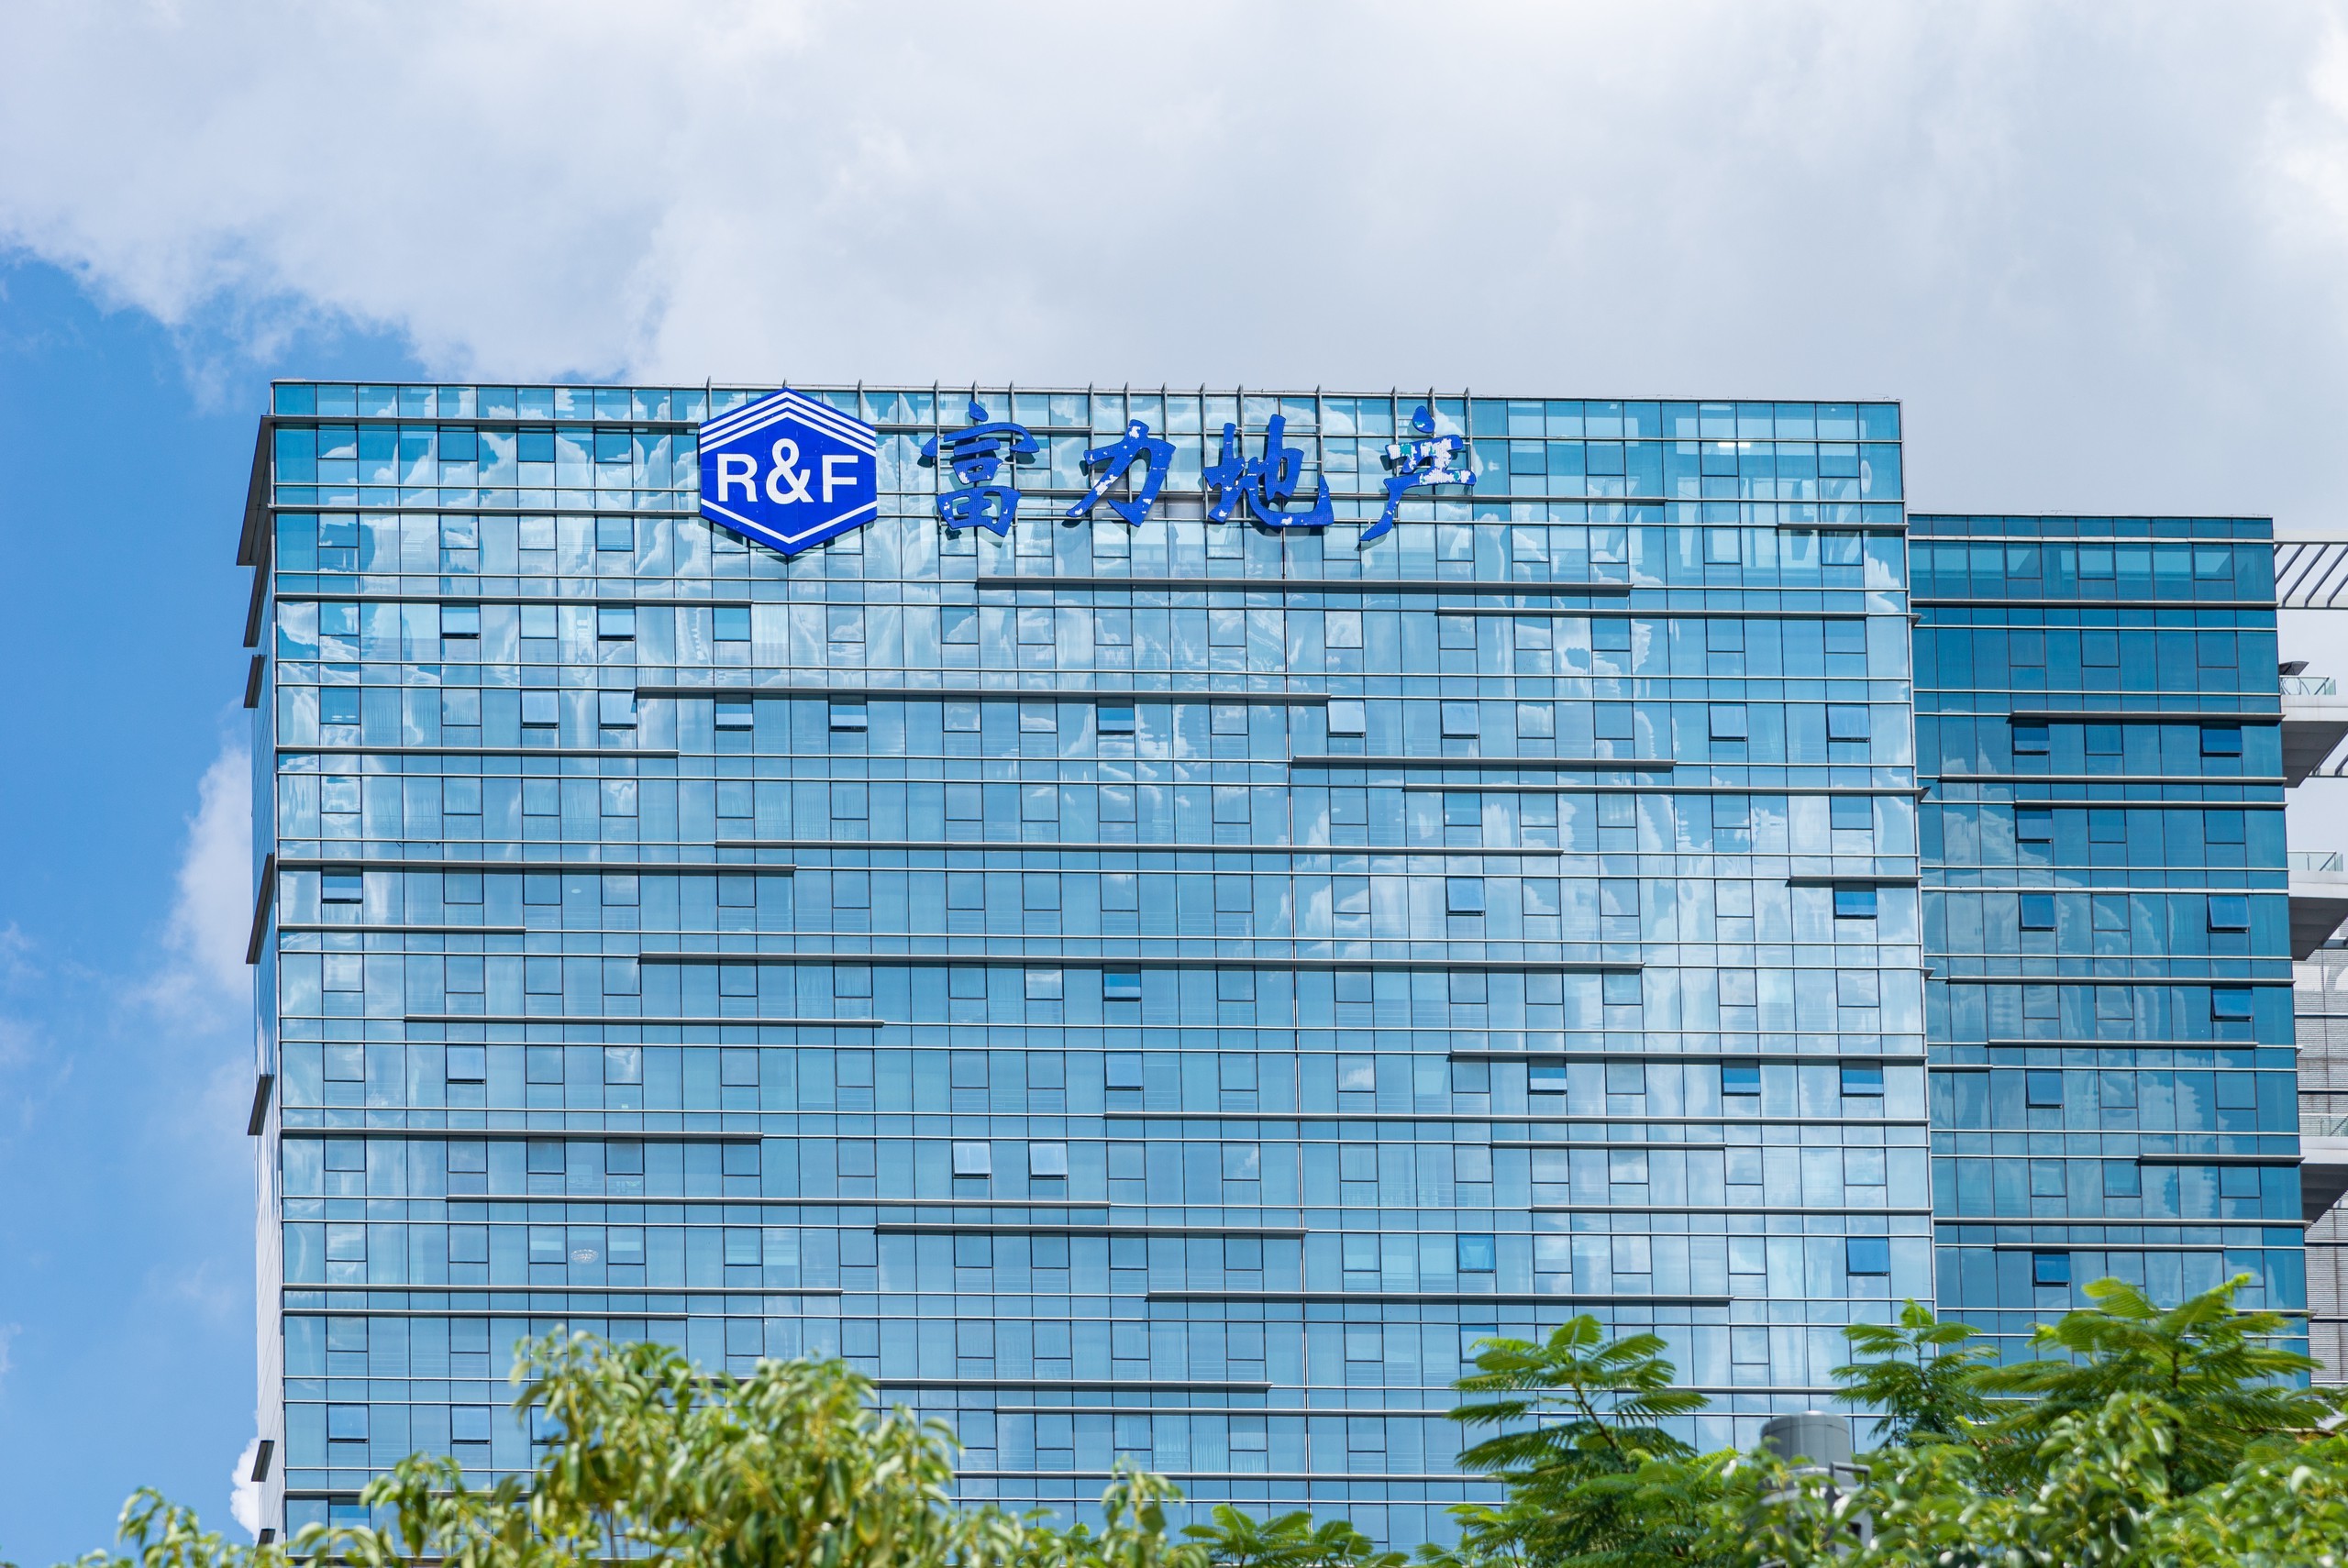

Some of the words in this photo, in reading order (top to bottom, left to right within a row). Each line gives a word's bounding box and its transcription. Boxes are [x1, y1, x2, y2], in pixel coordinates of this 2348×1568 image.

[716, 437, 858, 504] R&F
[921, 401, 1477, 542] 富力地产
